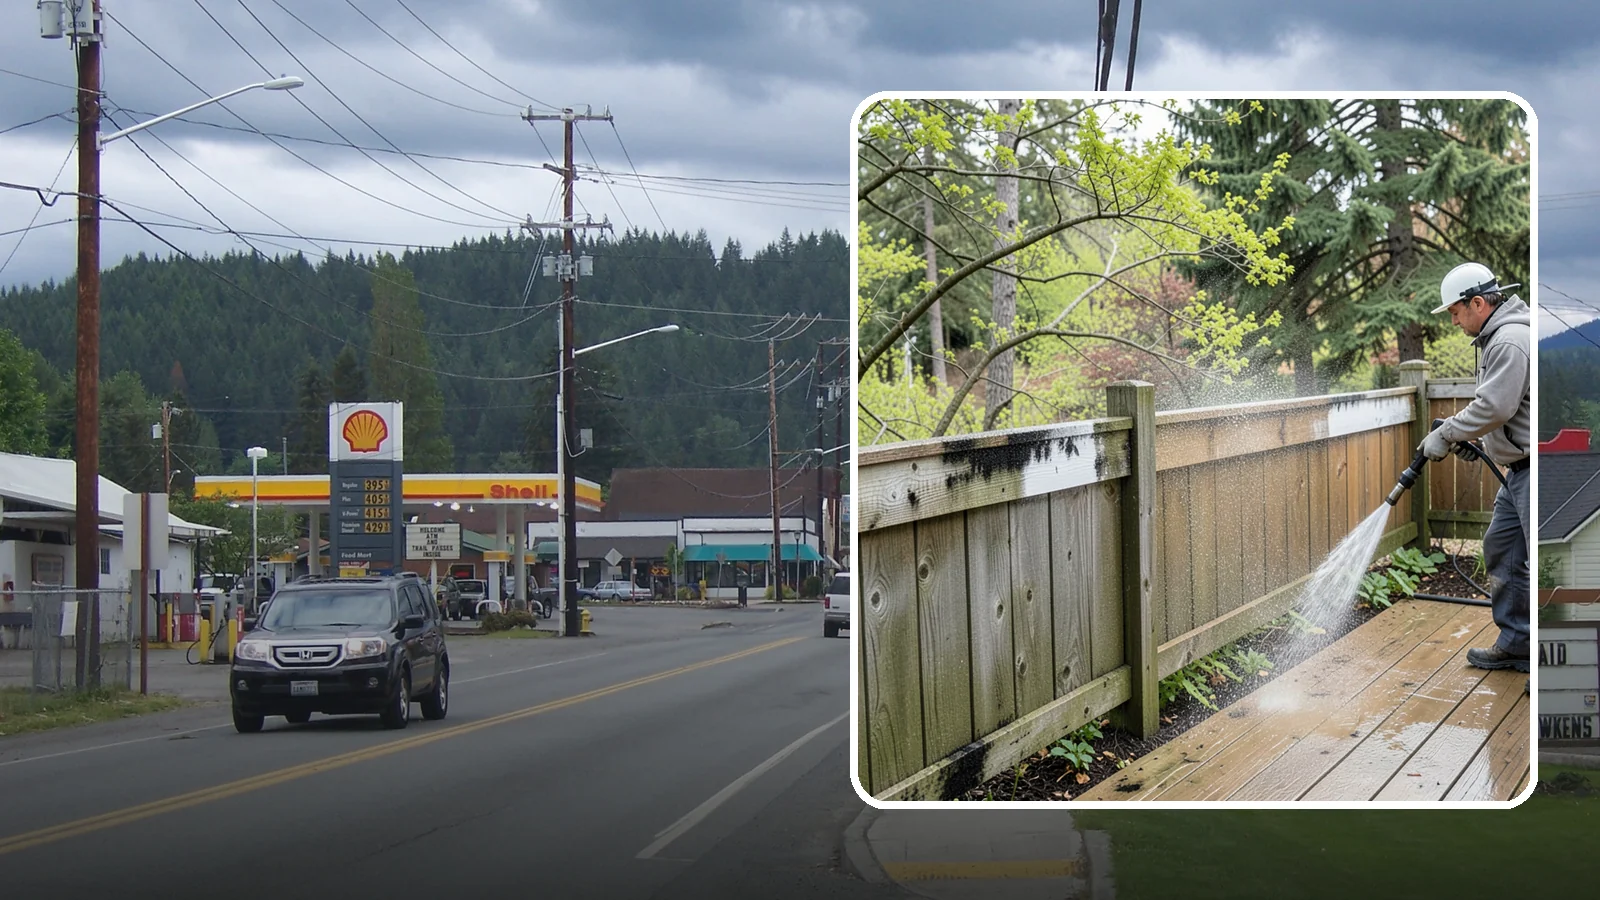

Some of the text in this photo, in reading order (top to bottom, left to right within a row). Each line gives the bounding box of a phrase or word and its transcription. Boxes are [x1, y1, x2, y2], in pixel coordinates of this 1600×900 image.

[366, 480, 384, 490] 395
[490, 484, 547, 498] Shell
[366, 494, 384, 504] 405
[366, 508, 383, 518] 415
[366, 522, 384, 532] 429
